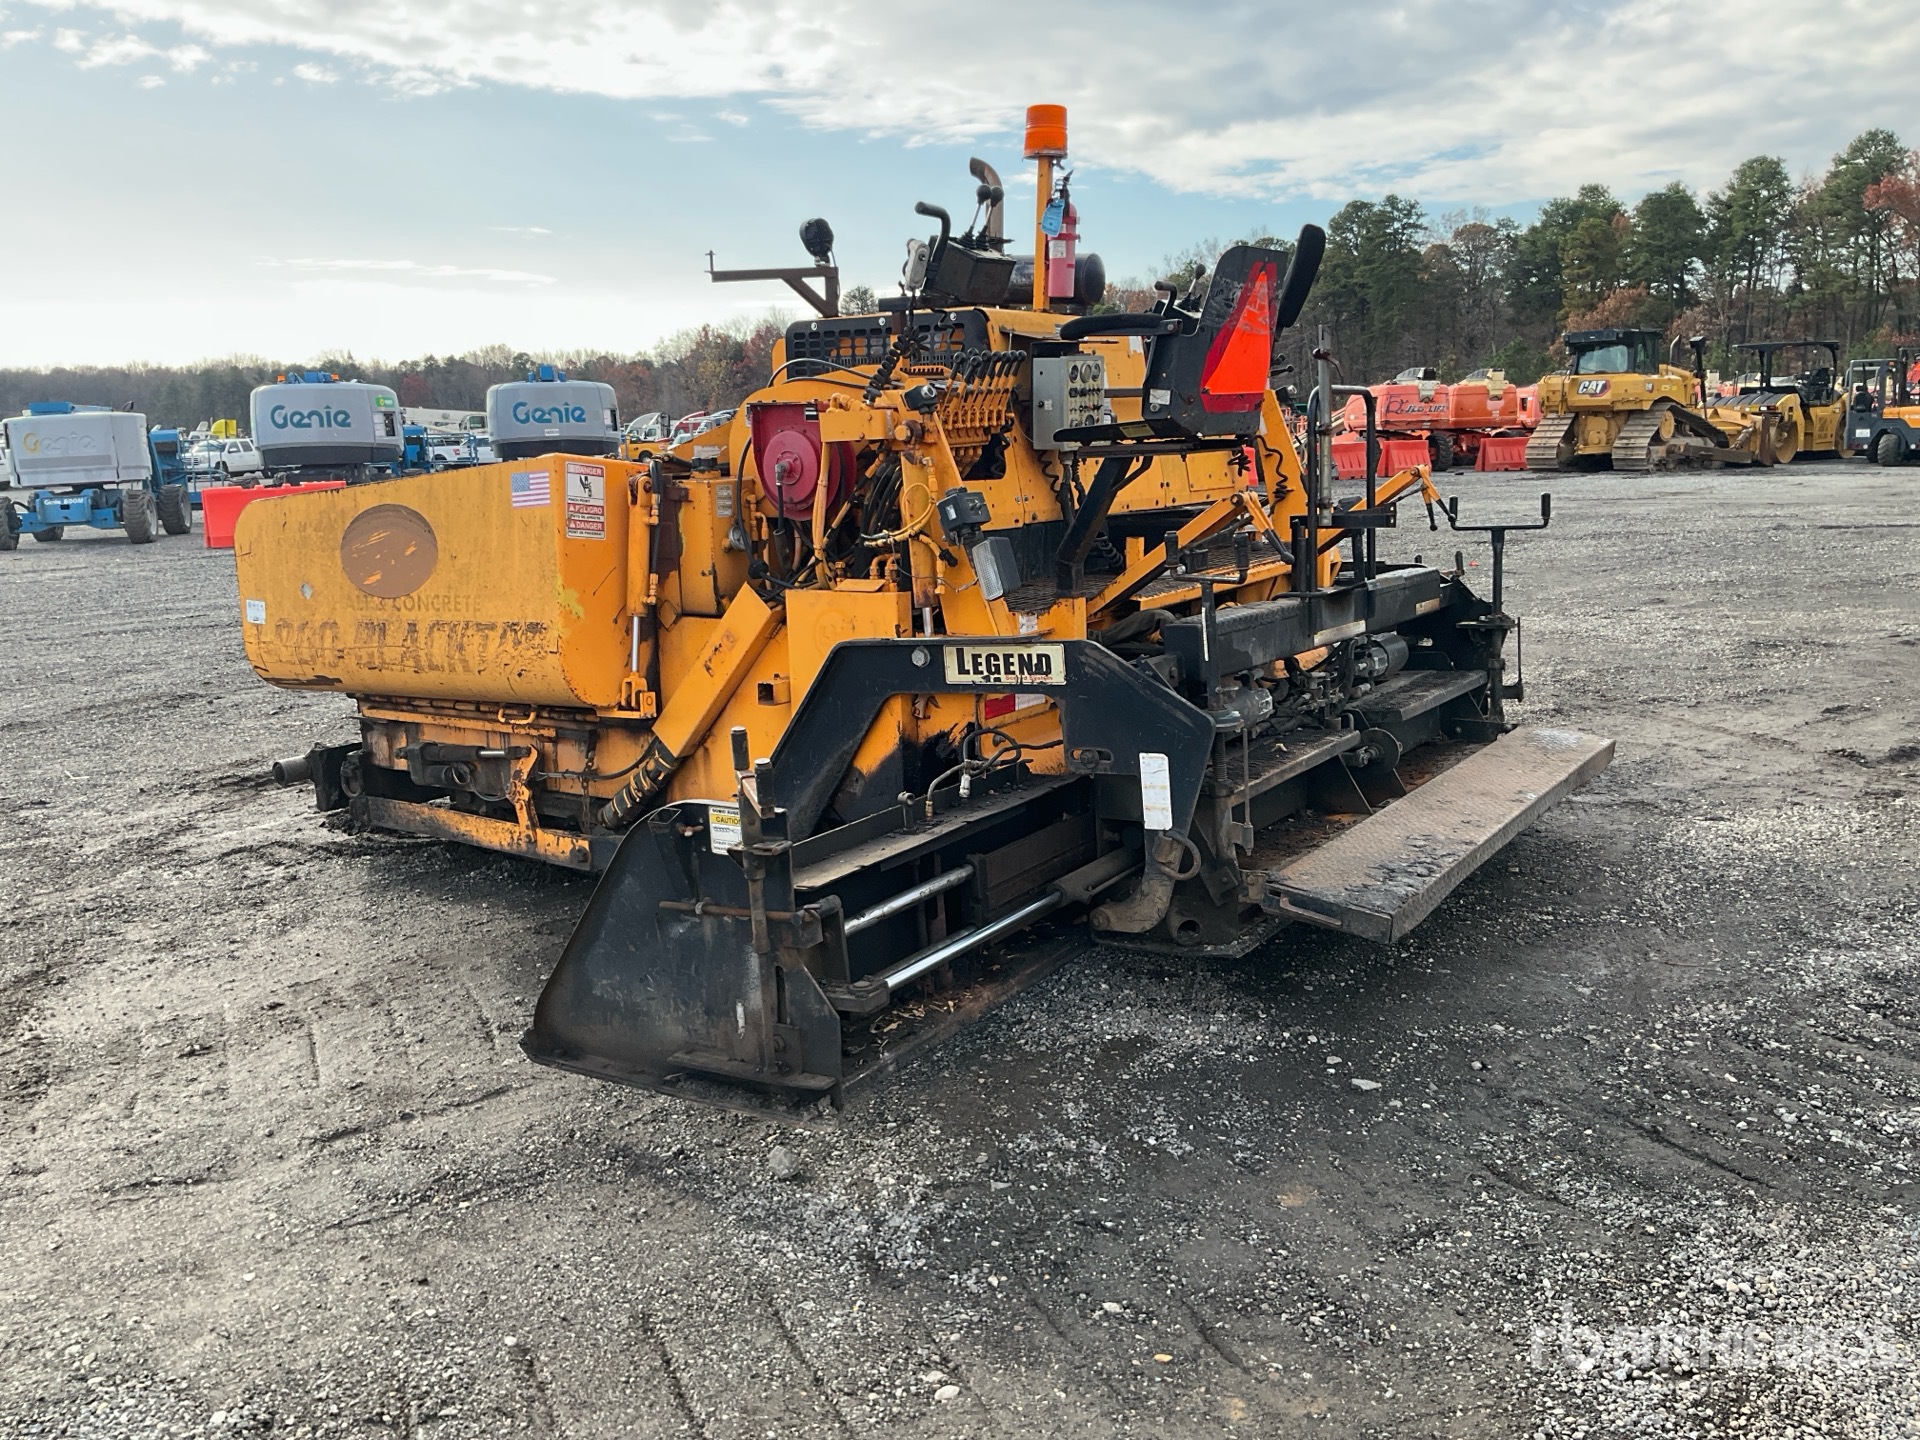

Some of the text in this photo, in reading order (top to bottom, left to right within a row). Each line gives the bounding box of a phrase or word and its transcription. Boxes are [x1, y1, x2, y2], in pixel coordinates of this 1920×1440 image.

[1577, 380, 1606, 394] CAT
[270, 404, 352, 430] Genie
[512, 401, 587, 425] Genie
[575, 466, 602, 476] DANGER
[575, 506, 603, 515] PELIGRO
[576, 521, 603, 530] DANGER
[392, 594, 482, 613] CONCRETE
[955, 647, 1052, 676] LEGEND
